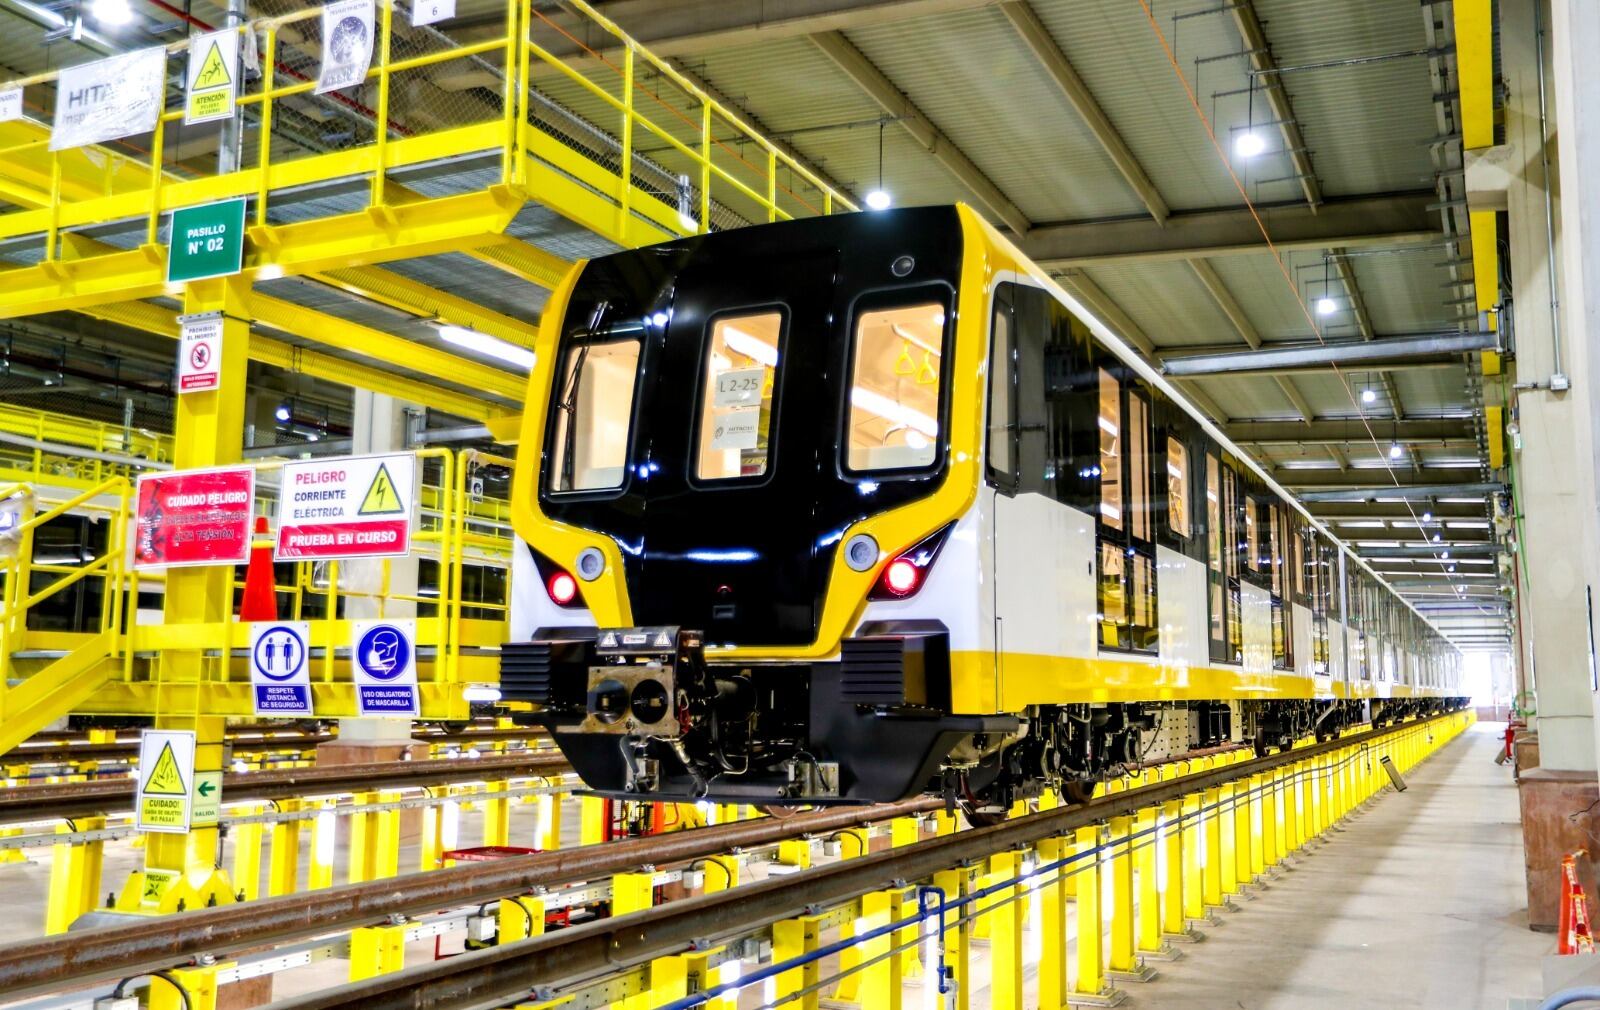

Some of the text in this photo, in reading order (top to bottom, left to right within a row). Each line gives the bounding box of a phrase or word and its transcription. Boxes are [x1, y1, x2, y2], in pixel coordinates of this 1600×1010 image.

[432, 6, 438, 16] 6
[196, 91, 226, 104] ATENCIÓN
[187, 224, 226, 239] PASILLO
[207, 237, 224, 252] 02
[720, 378, 759, 393] L 2-25
[167, 491, 248, 507] CUIDADO PELIGRO
[294, 490, 347, 502] CORRIENTE
[289, 531, 398, 547] PRUEBA EN CURSO
[363, 690, 412, 698] USO OBLIGATORIO
